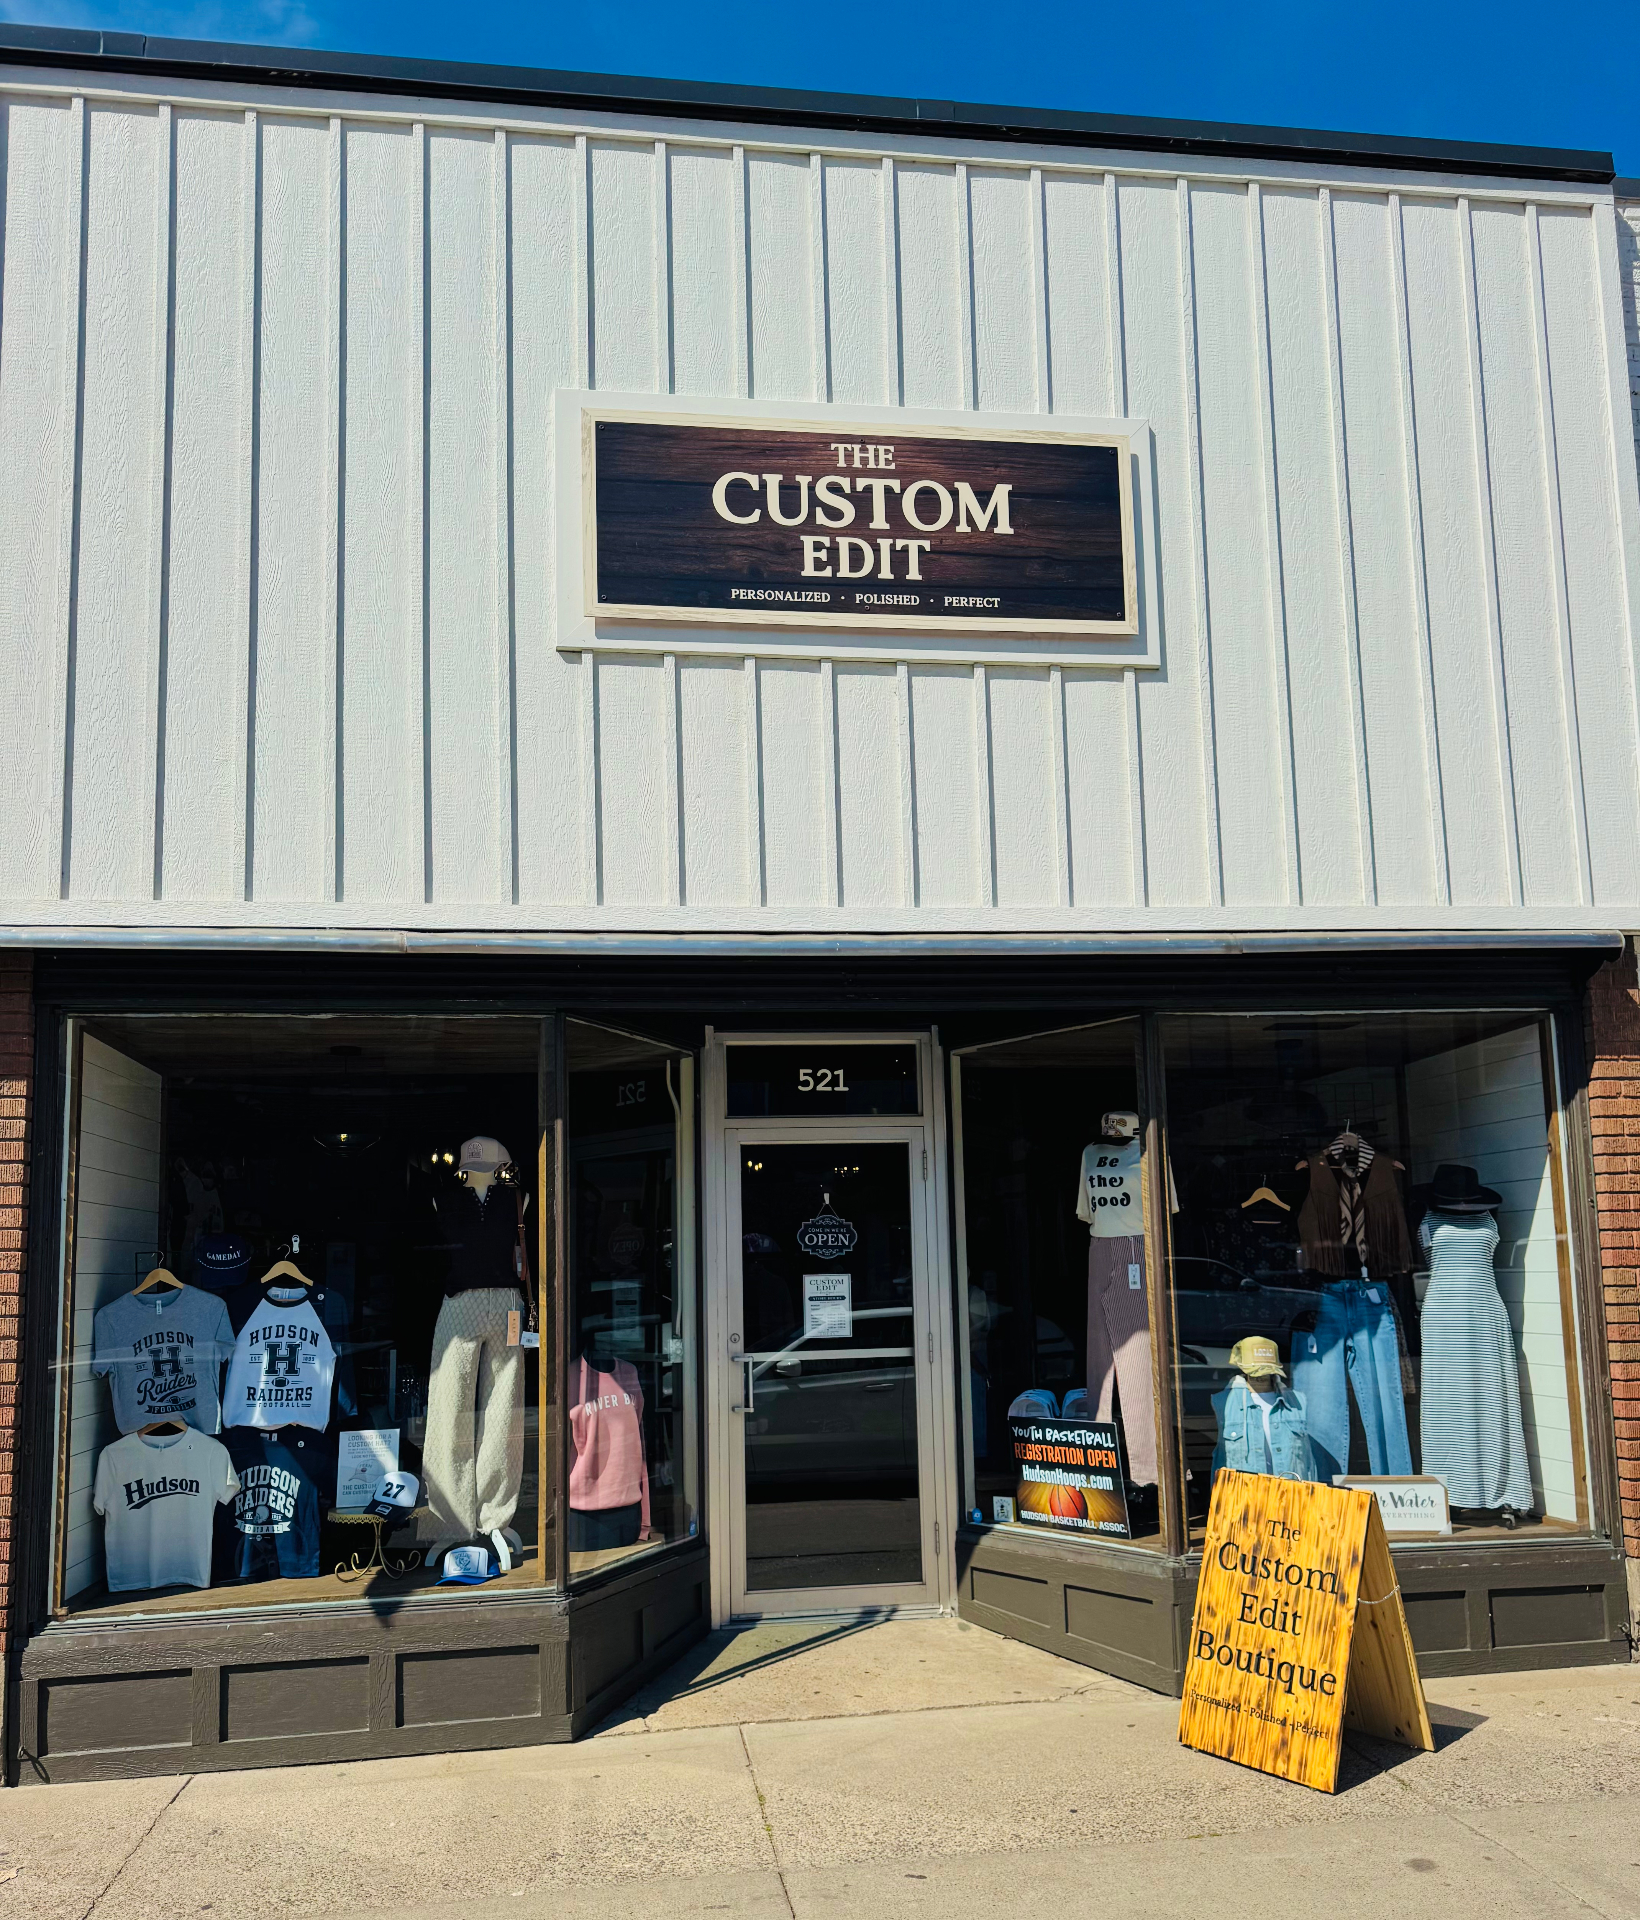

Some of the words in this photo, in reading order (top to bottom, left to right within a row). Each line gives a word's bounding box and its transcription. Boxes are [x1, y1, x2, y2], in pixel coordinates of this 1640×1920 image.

[830, 443, 896, 469] THE
[712, 472, 1014, 535] CUSTOM
[800, 535, 931, 580] EDIT
[731, 588, 831, 603] PERSONALIZED
[855, 593, 920, 606] POLISHED
[944, 596, 1001, 609] PERFECT
[798, 1068, 849, 1091] 521
[1096, 1156, 1120, 1168] Be
[1088, 1174, 1124, 1188] the
[1090, 1191, 1131, 1213] good
[804, 1233, 851, 1246] OPEN
[206, 1250, 241, 1261] GAMEDAY
[132, 1331, 194, 1357] HUDSON
[249, 1324, 320, 1348] HUDSON
[148, 1345, 183, 1378] H
[263, 1342, 302, 1376] H
[137, 1373, 197, 1406] Raiders
[246, 1386, 313, 1401] RAIDERS
[585, 1394, 619, 1416] RIVER
[1012, 1426, 1043, 1441] YOUTH
[1045, 1428, 1115, 1448] BASKETBALL
[1014, 1443, 1085, 1466] REGISTRATION
[1087, 1449, 1117, 1469] OPEN
[238, 1465, 301, 1500] HUDSON
[382, 1482, 406, 1499] 27
[1022, 1464, 1114, 1491] HudsonHoops.com
[123, 1476, 200, 1506] Hudson
[235, 1487, 295, 1518] RAIDERS
[1389, 1488, 1437, 1509] Water
[1021, 1510, 1048, 1522] HUDSON
[1050, 1514, 1097, 1529] BASKETBALL
[1099, 1522, 1128, 1533] ASSOC.
[1267, 1519, 1301, 1541] The
[1218, 1541, 1338, 1595] Custom
[1236, 1592, 1302, 1636] Edit
[1194, 1629, 1337, 1696] Boutique
[1190, 1689, 1241, 1713] Personalized
[1249, 1707, 1287, 1727] Polished
[1295, 1721, 1330, 1740] Perfect
